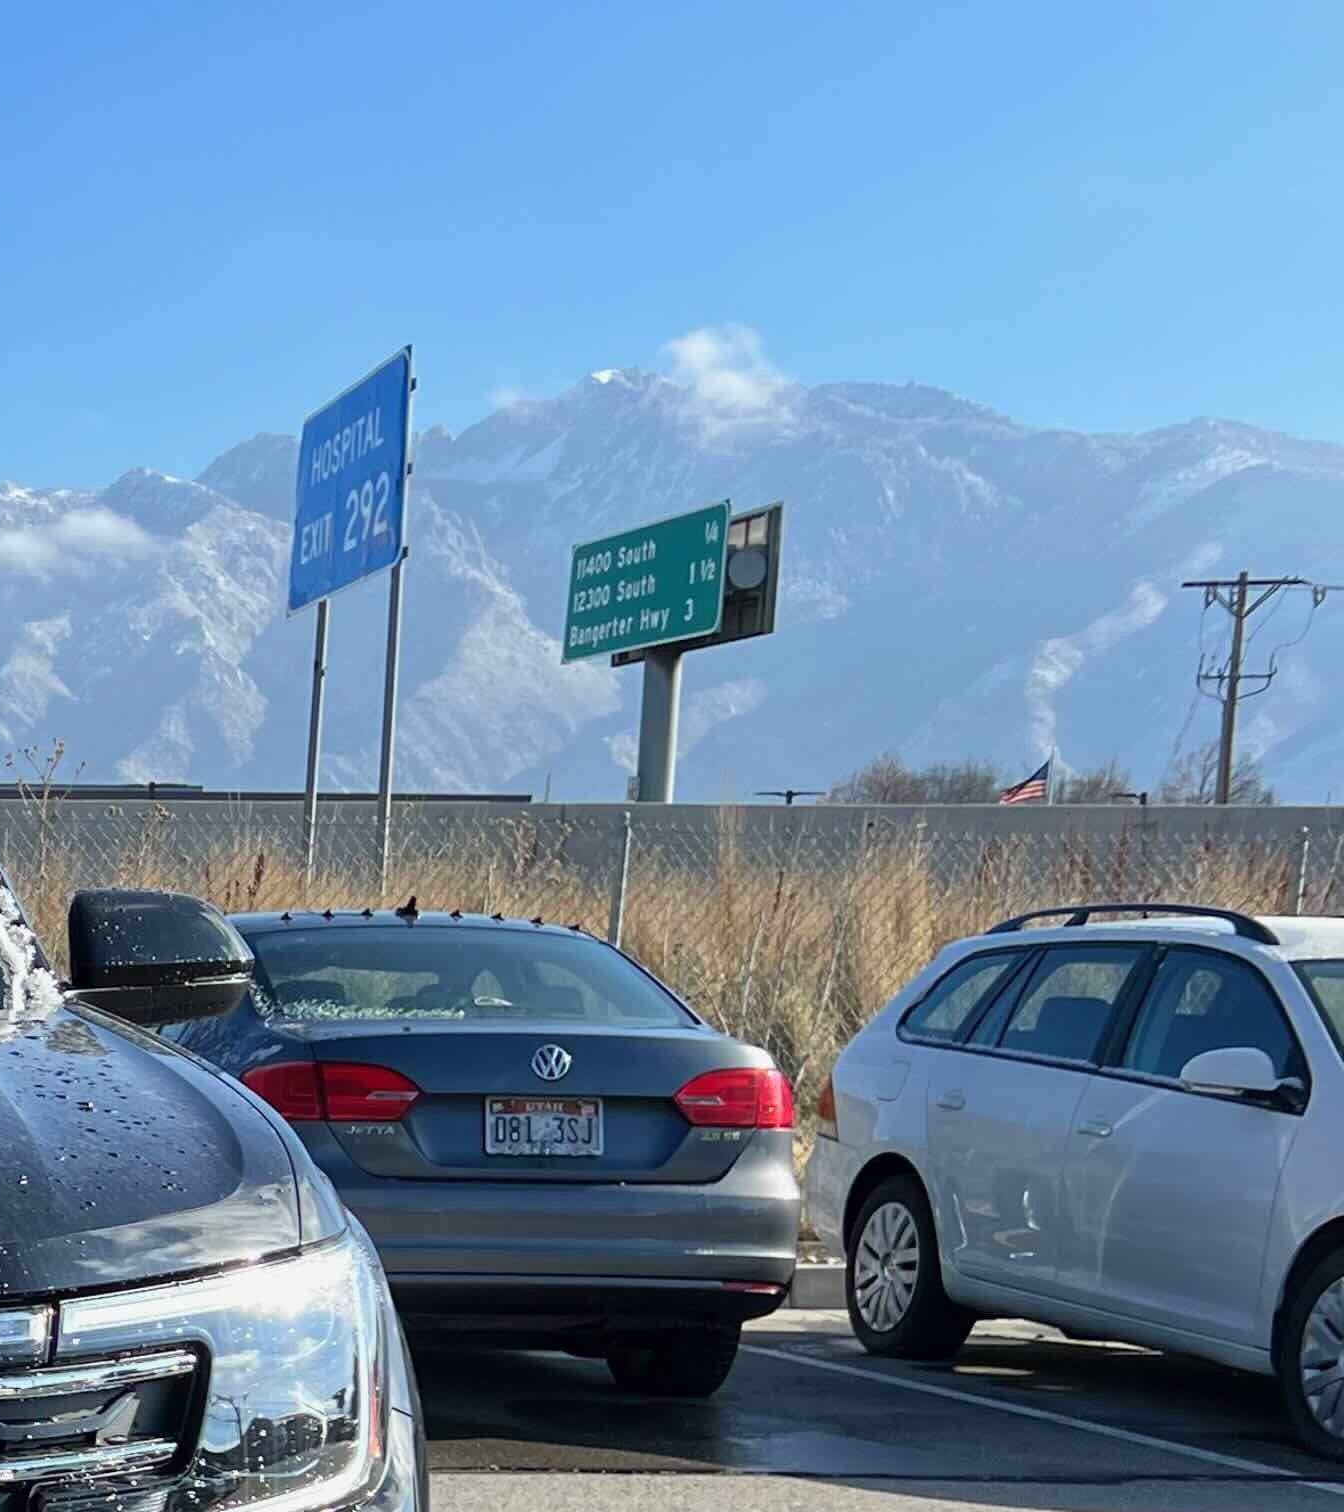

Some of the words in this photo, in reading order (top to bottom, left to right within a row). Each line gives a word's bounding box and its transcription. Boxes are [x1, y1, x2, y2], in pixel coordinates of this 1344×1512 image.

[311, 407, 384, 487] HOSPITAL
[300, 512, 333, 565] EXIT
[343, 471, 390, 552] 292
[576, 551, 611, 580] 11400
[617, 539, 656, 568] South
[573, 584, 610, 614] 12300
[616, 573, 655, 602] South
[569, 616, 634, 648] Bangerter
[640, 607, 670, 632] Hwy
[684, 598, 694, 621] 3
